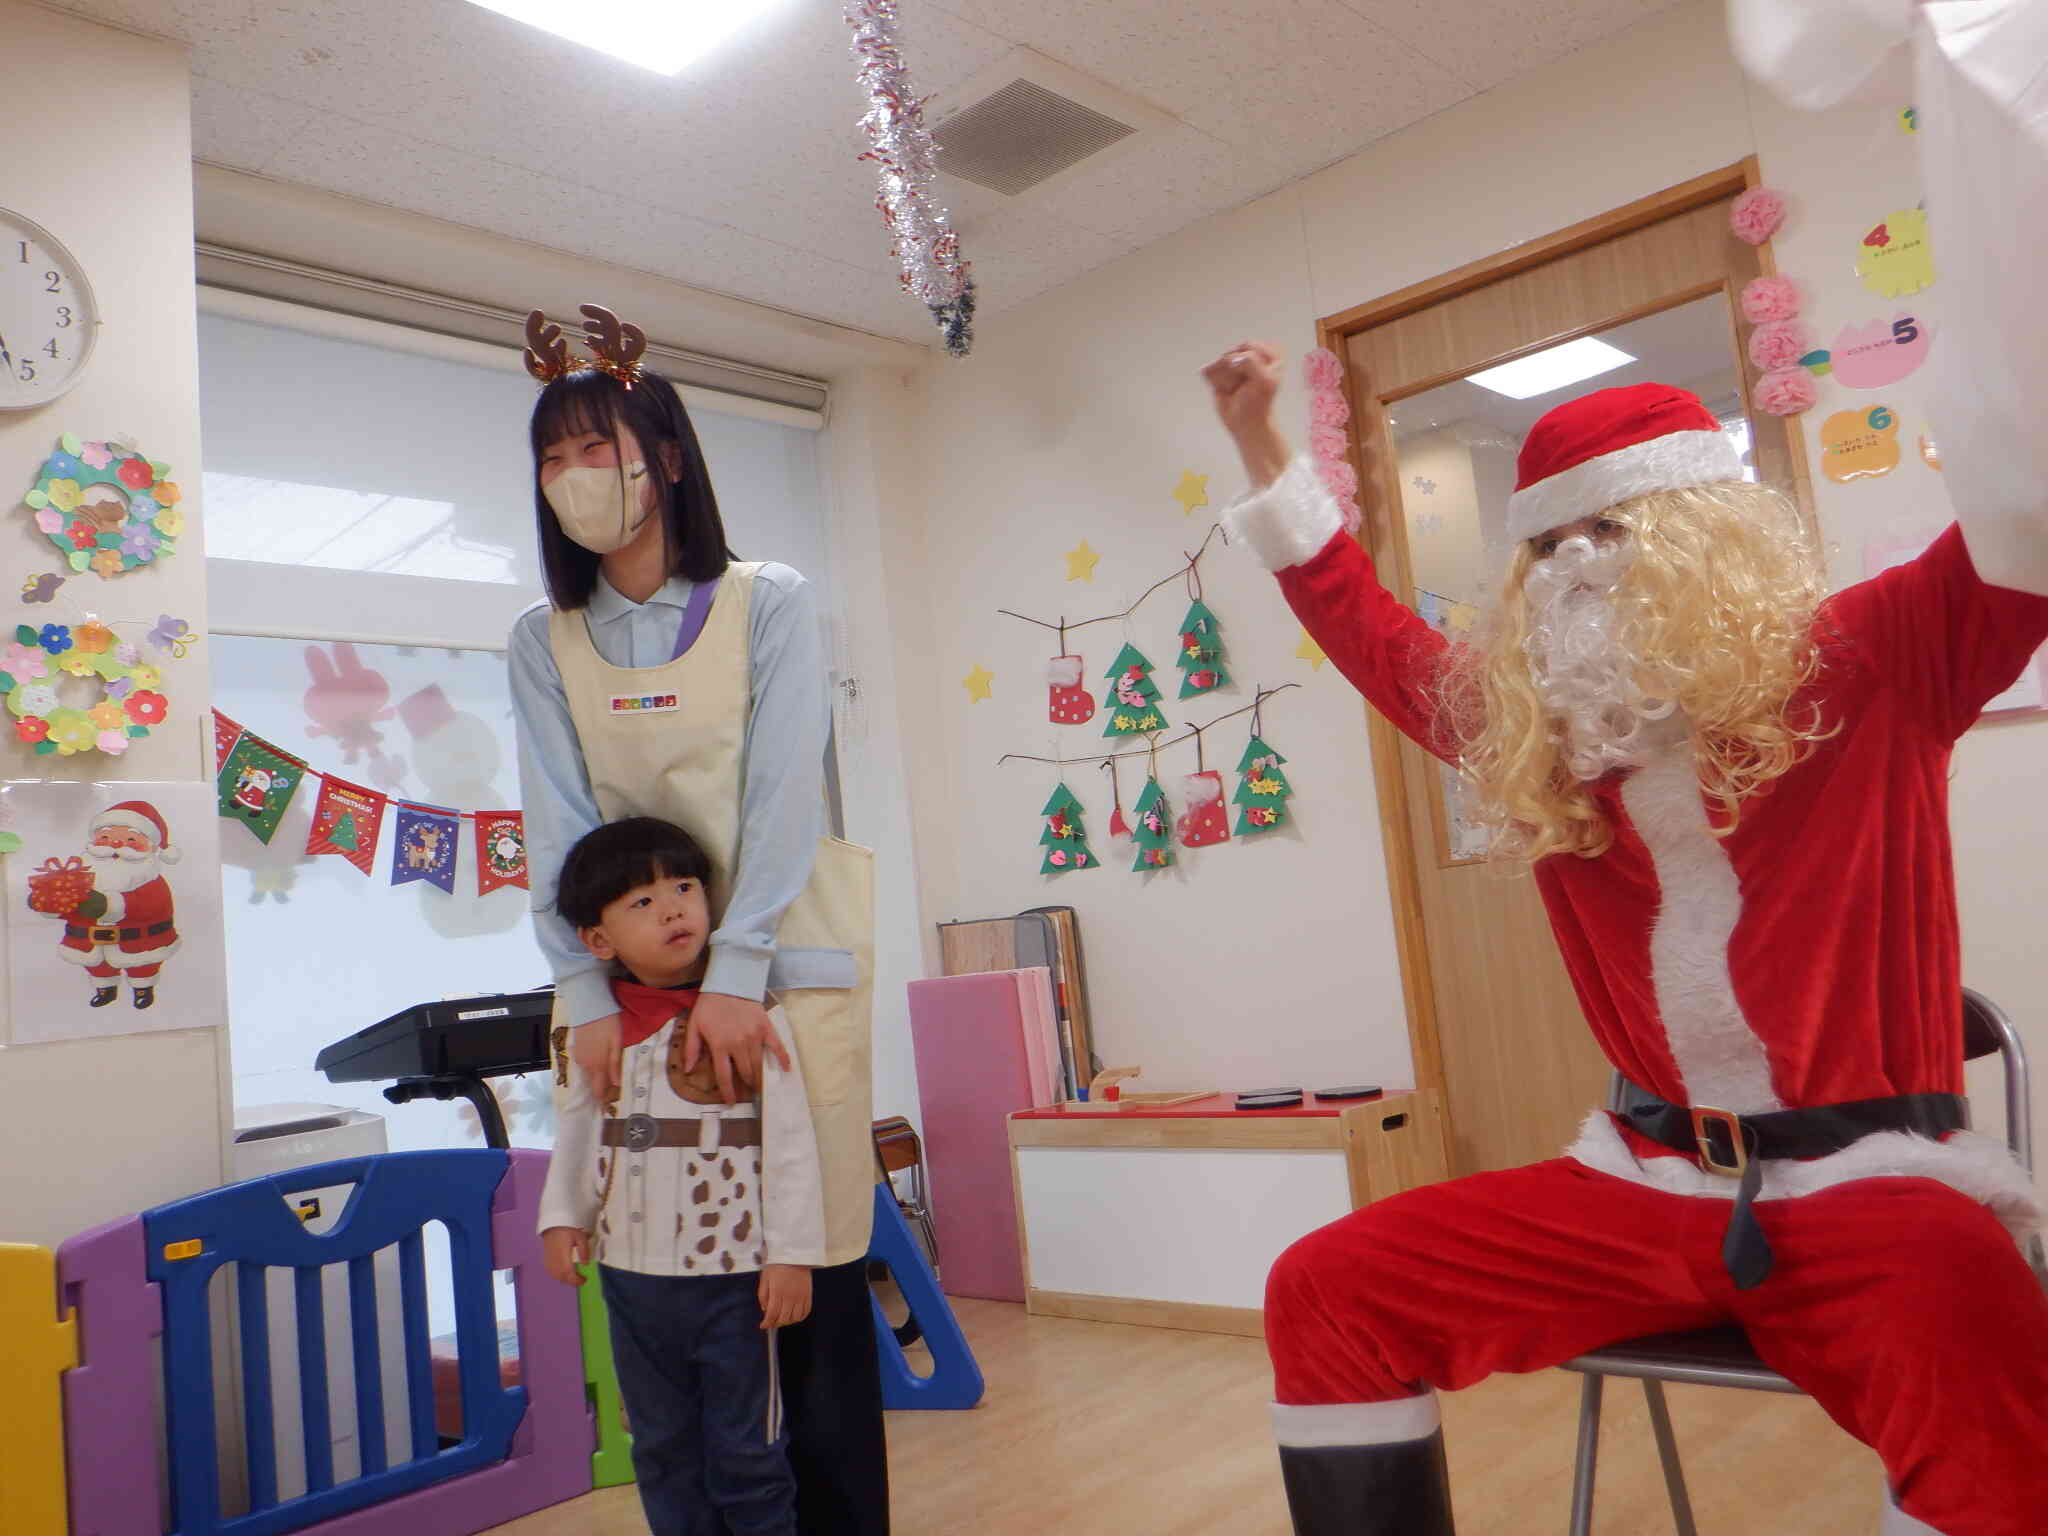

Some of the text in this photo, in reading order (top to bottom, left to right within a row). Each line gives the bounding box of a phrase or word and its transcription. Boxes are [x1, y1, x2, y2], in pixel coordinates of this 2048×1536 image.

[1863, 224, 1890, 247] 4
[18, 241, 30, 263] 1
[45, 271, 61, 293] 2
[56, 306, 71, 328] 3
[1893, 317, 1918, 344] 5
[43, 337, 59, 359] 4
[19, 359, 36, 381] 5
[1868, 407, 1892, 430] 6
[491, 819, 516, 830] HAPPY
